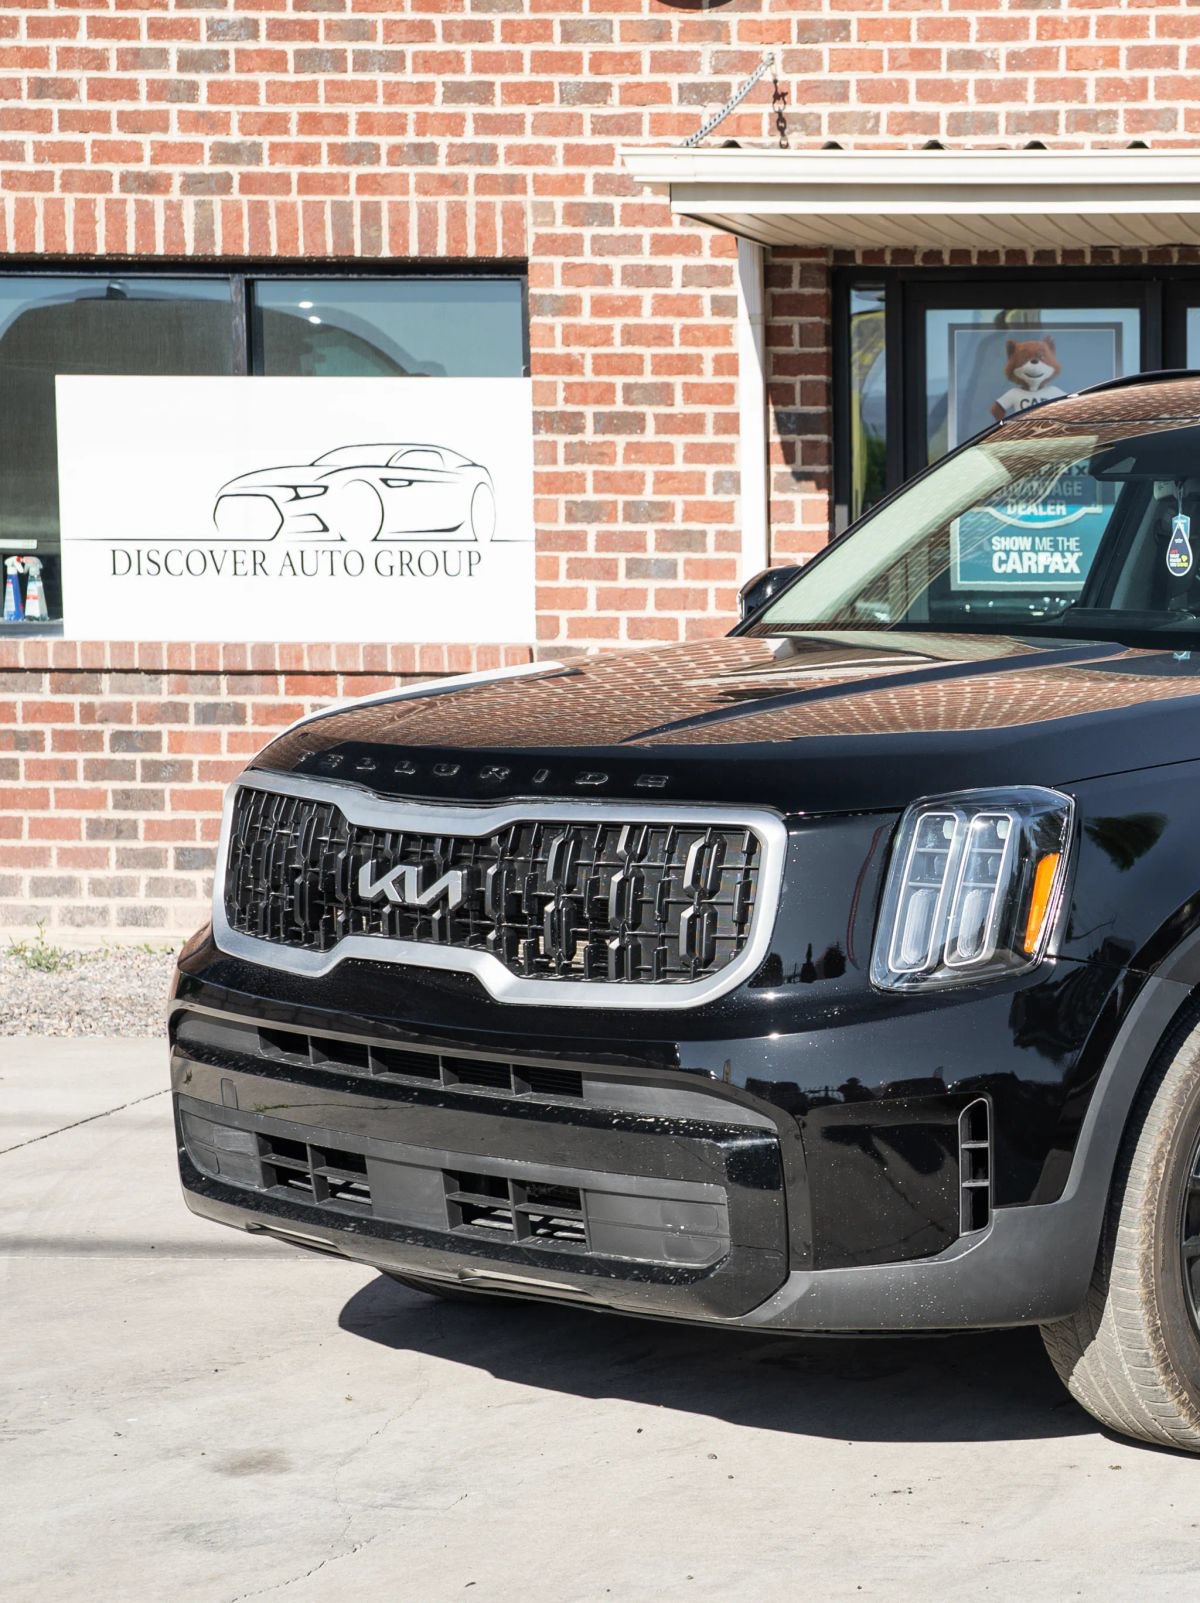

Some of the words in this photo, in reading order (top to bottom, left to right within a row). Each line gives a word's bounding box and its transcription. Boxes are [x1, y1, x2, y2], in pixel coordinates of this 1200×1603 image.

[1007, 501, 1066, 515] DEALER
[992, 536, 1031, 550] SHOW
[1035, 537, 1054, 551] ME
[1056, 537, 1080, 551] THE
[111, 549, 269, 577] DISCOVER
[278, 549, 365, 577] AUTO
[374, 549, 482, 577] GROUP
[992, 552, 1081, 573] CARFAX
[359, 860, 462, 910] KIA
